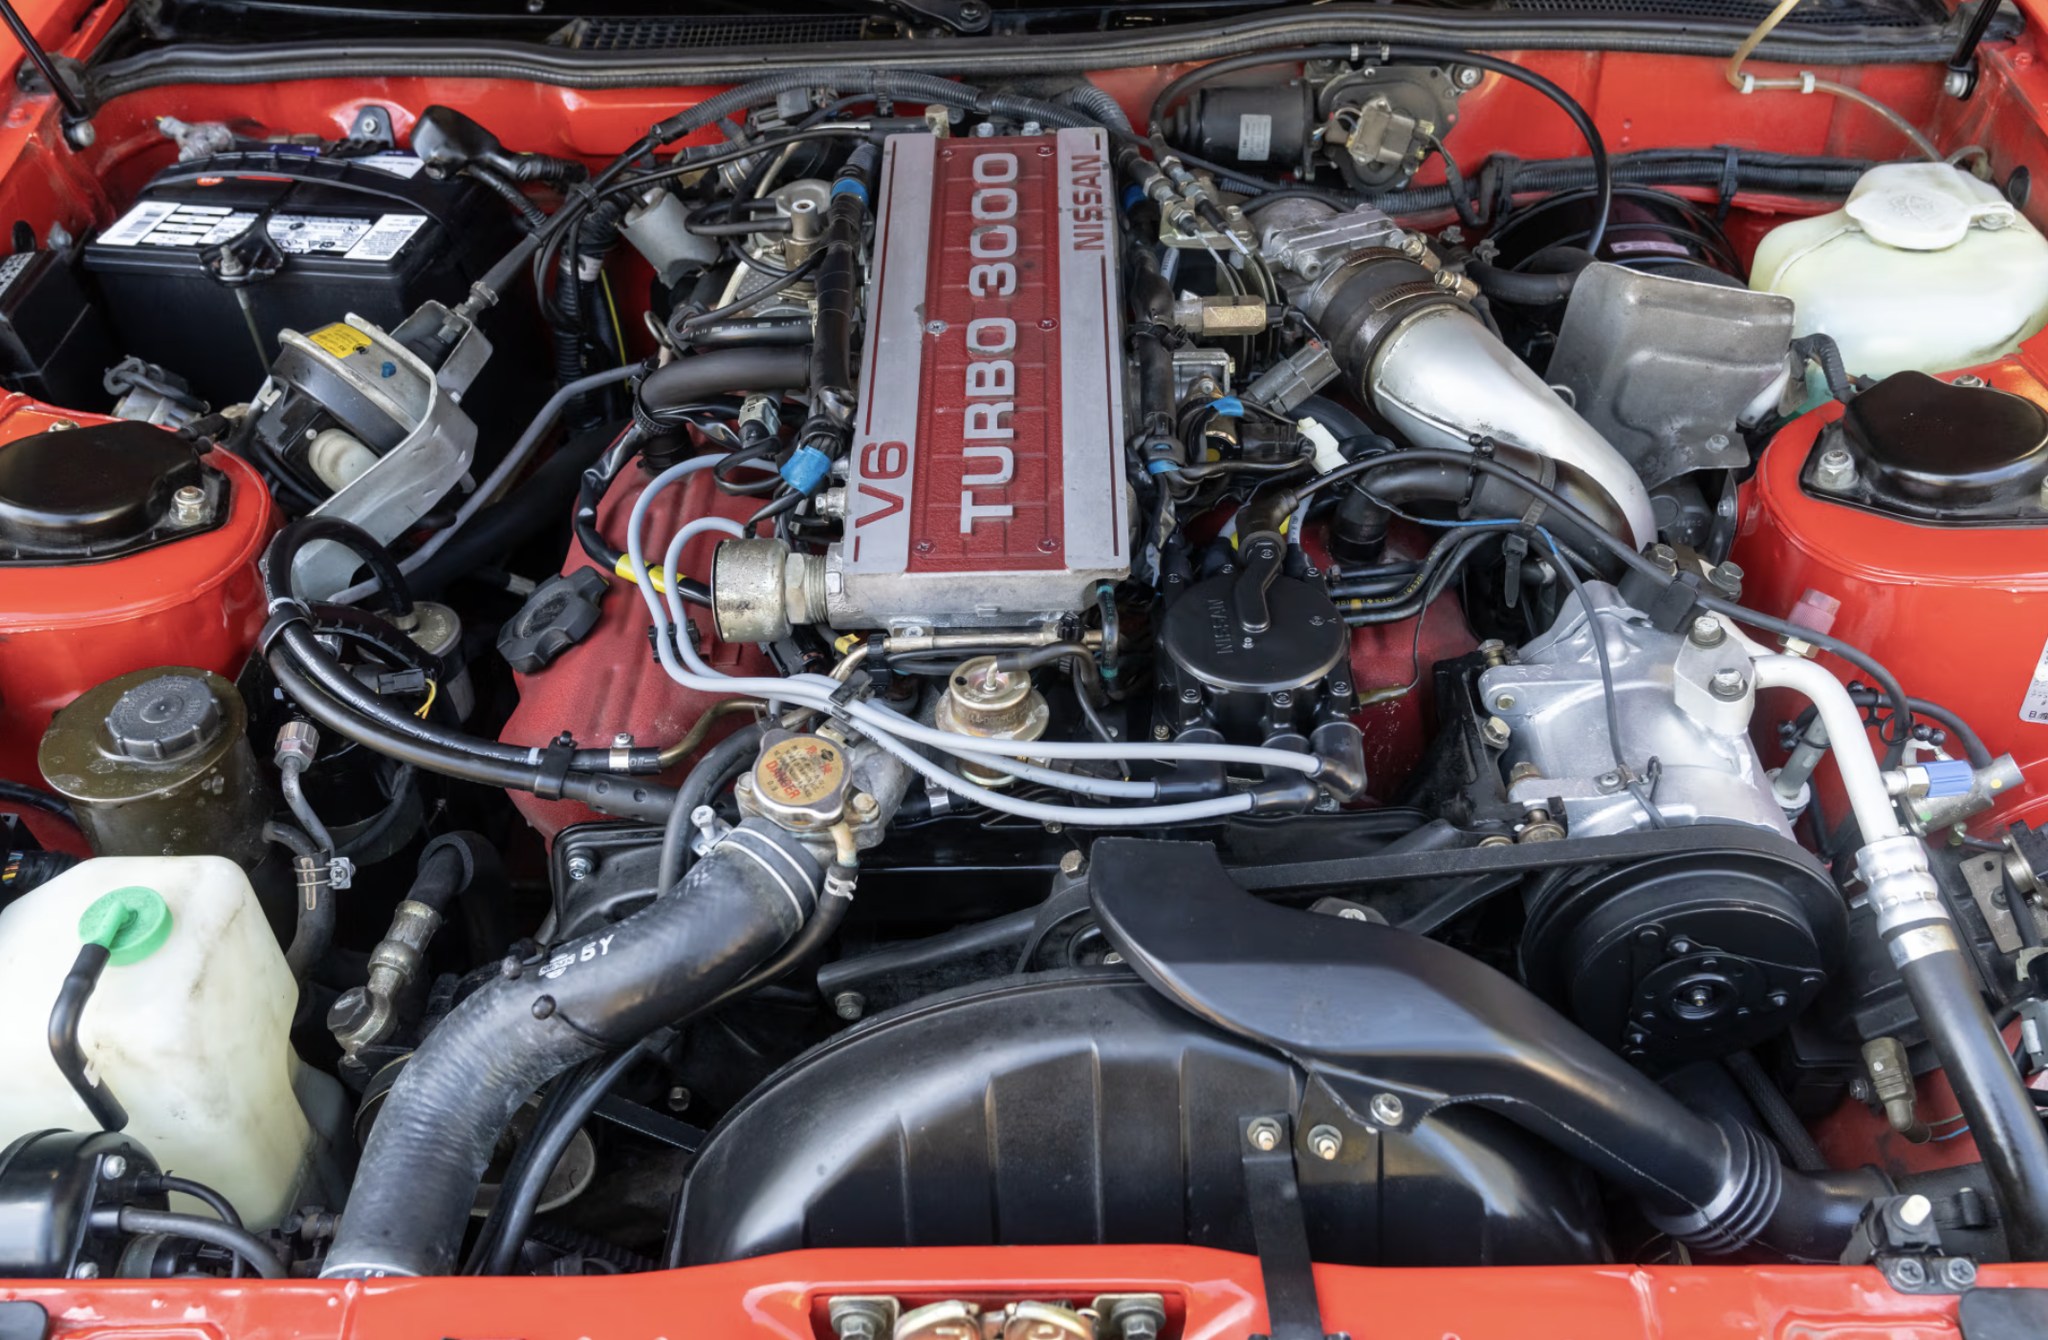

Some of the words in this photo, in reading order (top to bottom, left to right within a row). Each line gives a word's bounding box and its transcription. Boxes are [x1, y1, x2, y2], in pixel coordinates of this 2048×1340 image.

[968, 152, 1018, 297] 3000
[1071, 154, 1106, 251] NISSAN
[960, 317, 1017, 534] TURBO
[855, 440, 908, 529] V6
[765, 760, 801, 799] DANGER
[579, 934, 615, 962] 5Y
